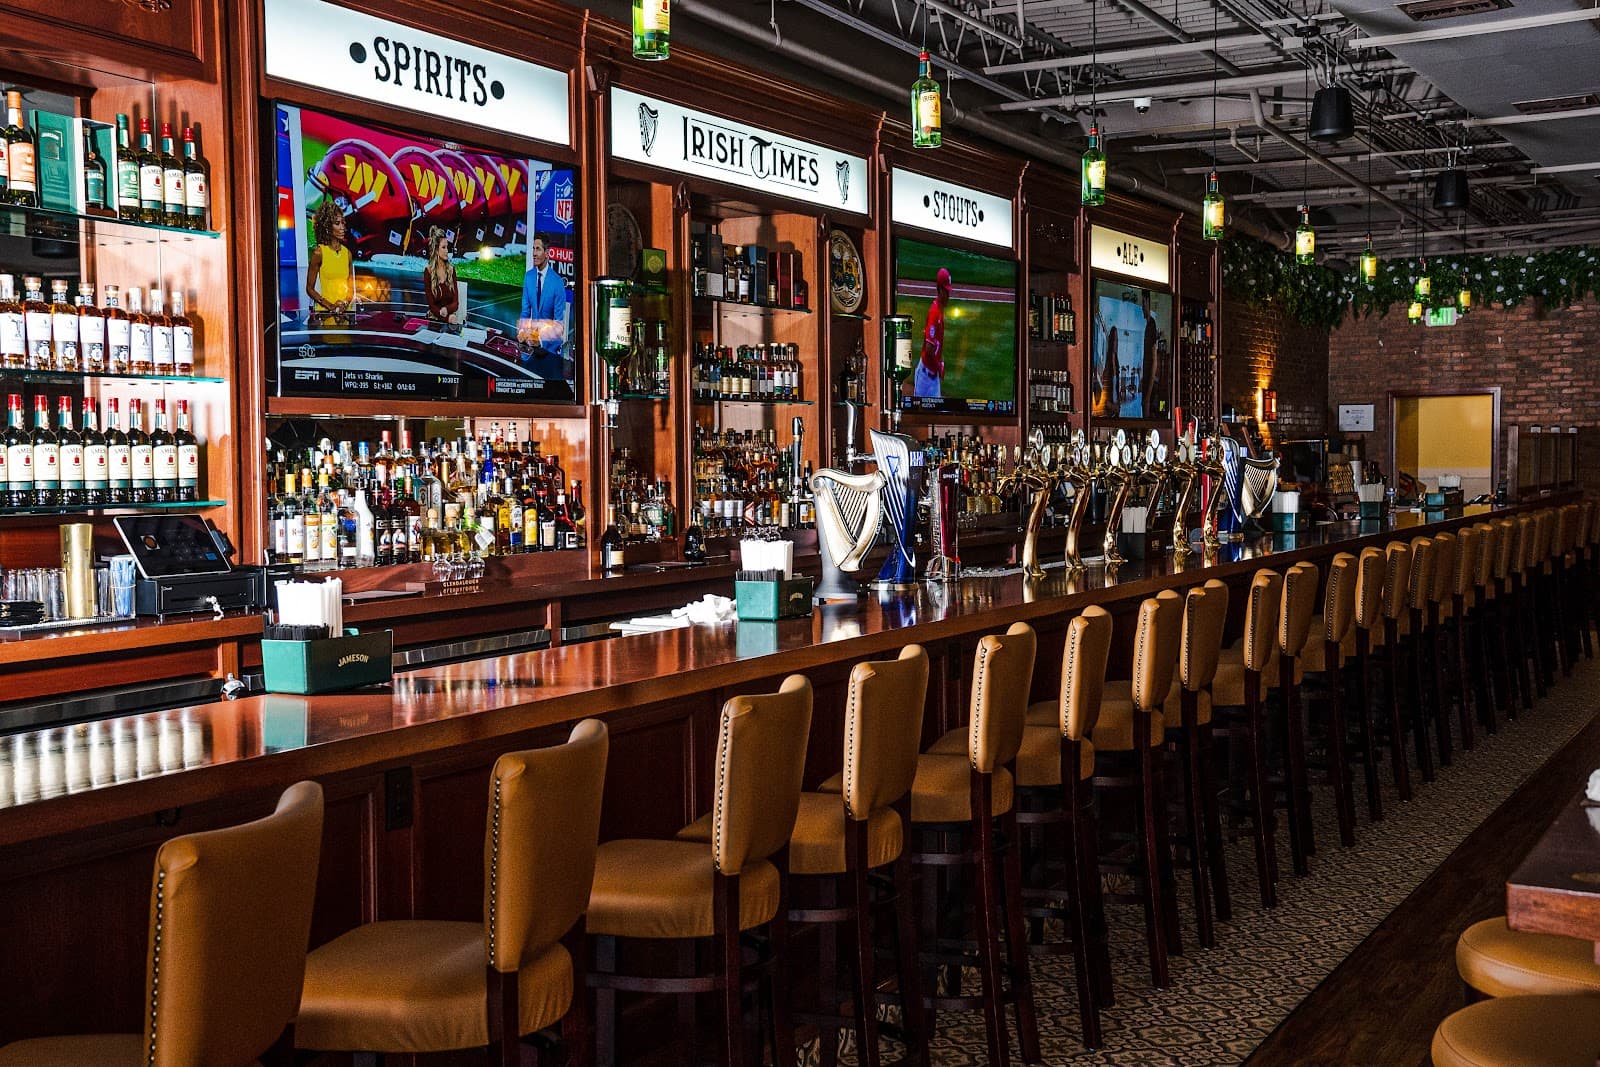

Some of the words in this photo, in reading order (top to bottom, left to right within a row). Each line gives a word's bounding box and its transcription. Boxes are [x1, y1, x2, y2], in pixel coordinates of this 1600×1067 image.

[373, 36, 487, 107] SPIRITS
[682, 115, 744, 169] IRISH
[749, 135, 820, 187] TIMES
[933, 190, 979, 228] STOUTS
[1122, 242, 1139, 267] ALE
[294, 370, 320, 381] ESPN
[365, 373, 384, 381] Sharks
[337, 653, 369, 667] JAMESON
